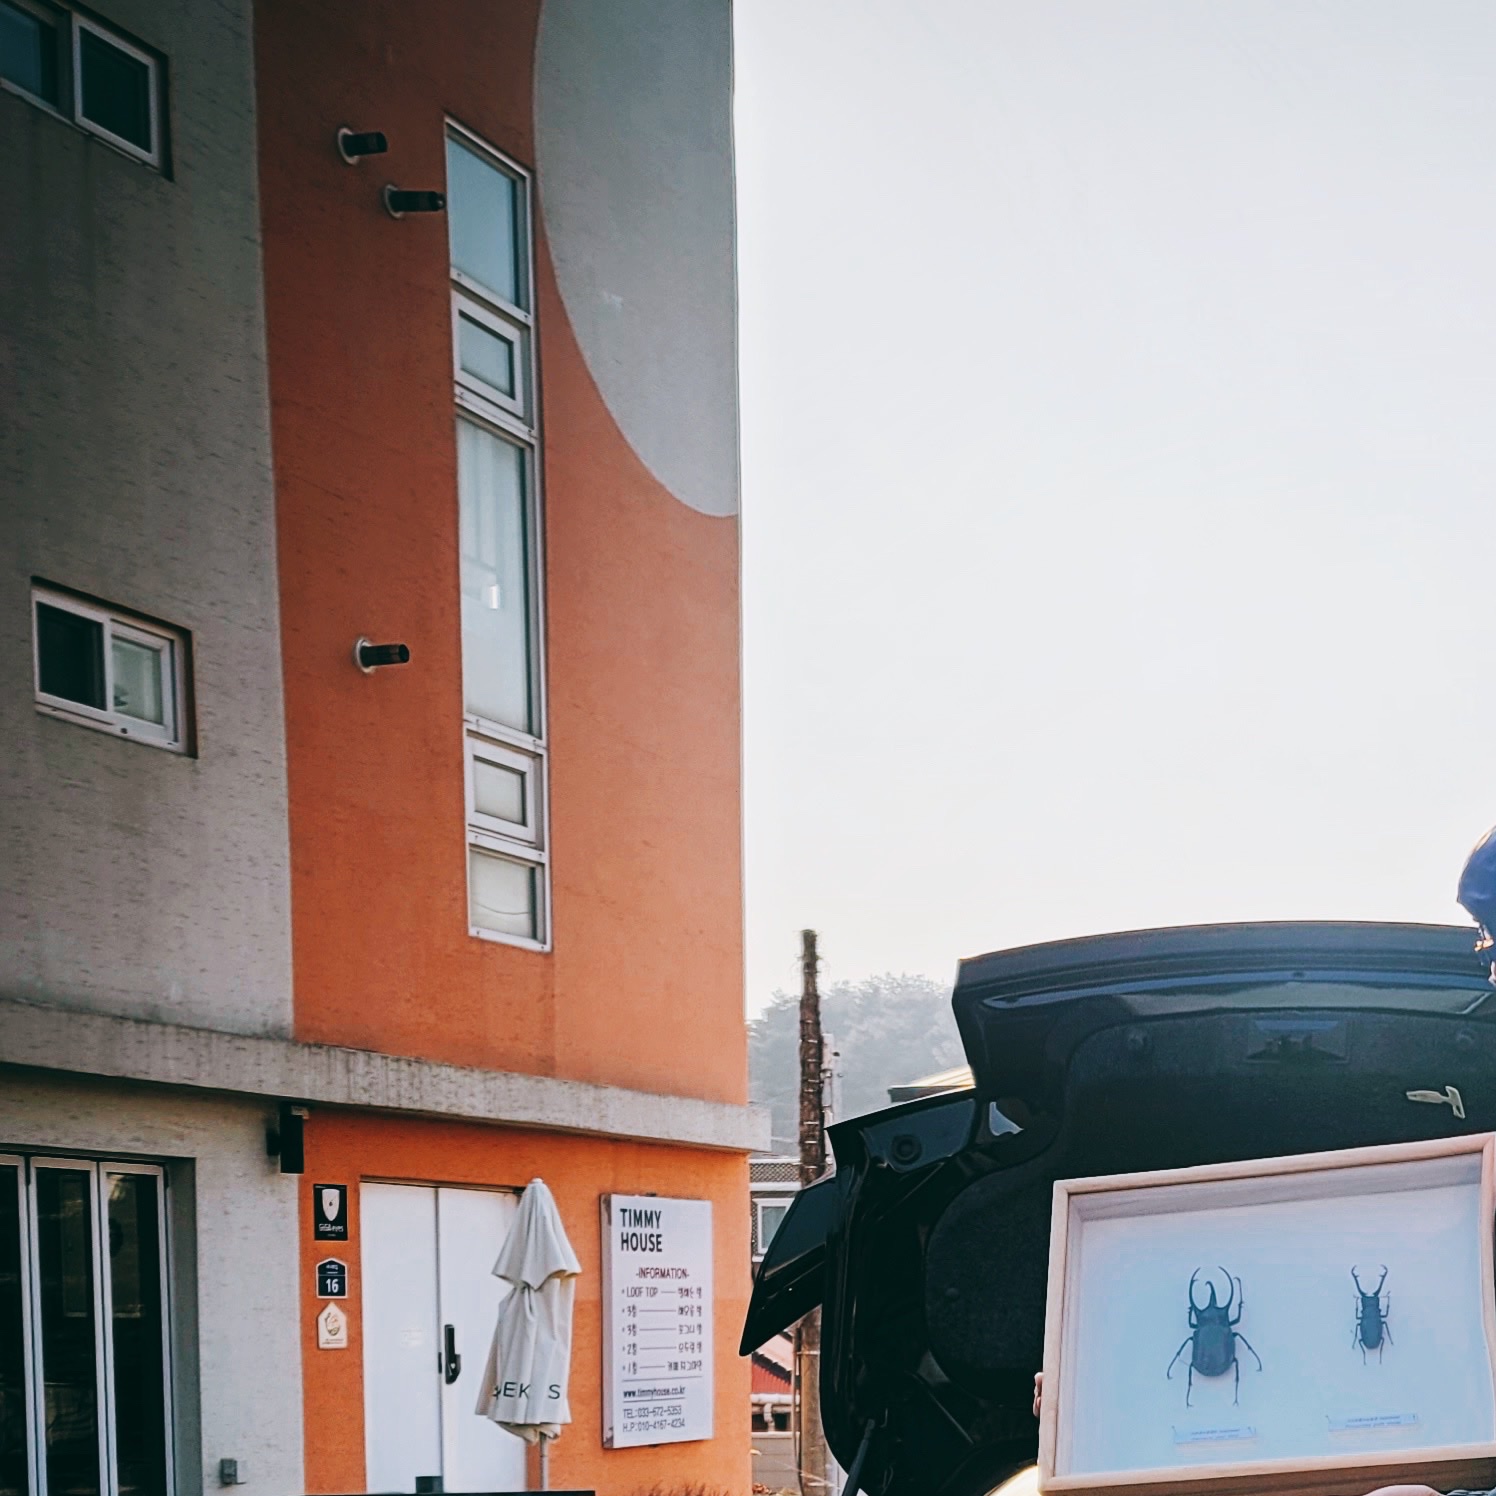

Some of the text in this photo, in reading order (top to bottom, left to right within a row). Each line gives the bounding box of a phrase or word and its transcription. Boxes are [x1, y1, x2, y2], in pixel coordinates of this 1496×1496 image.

[620, 1208, 662, 1229] TIMMY
[621, 1232, 663, 1253] HOUSE
[325, 1278, 340, 1294] 16
[645, 1286, 658, 1298] TOP
